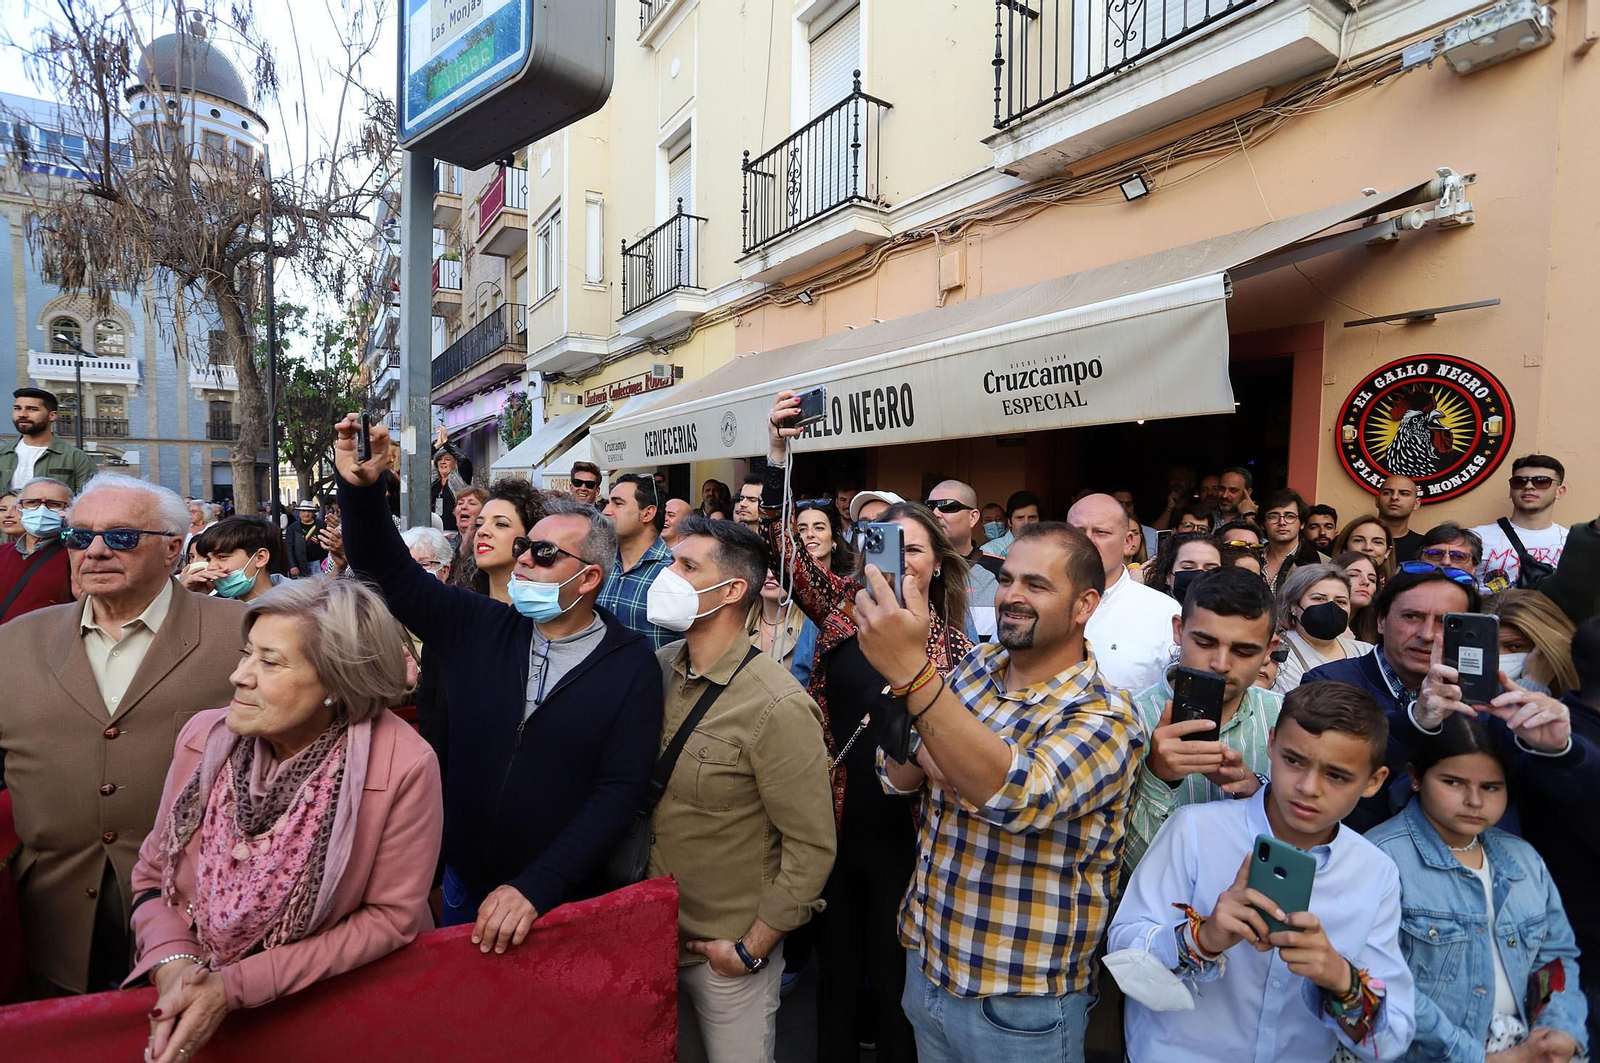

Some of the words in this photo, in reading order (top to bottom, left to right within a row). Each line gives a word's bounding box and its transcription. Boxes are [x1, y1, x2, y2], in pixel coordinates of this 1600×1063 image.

[431, 23, 445, 42] Las
[449, 0, 482, 28] Monjas
[608, 381, 643, 400] Confecciones
[983, 358, 1103, 394] Cruzcampo
[1353, 391, 1373, 408] EL
[1374, 363, 1428, 389] GALLO
[1436, 364, 1490, 399] NEGRO
[644, 422, 699, 458] CERVECERIAS
[848, 382, 915, 434] NEGRO
[1001, 390, 1088, 416] ESPECIAL
[605, 440, 627, 453] Cruzcampo
[1428, 455, 1486, 495] MONJAS
